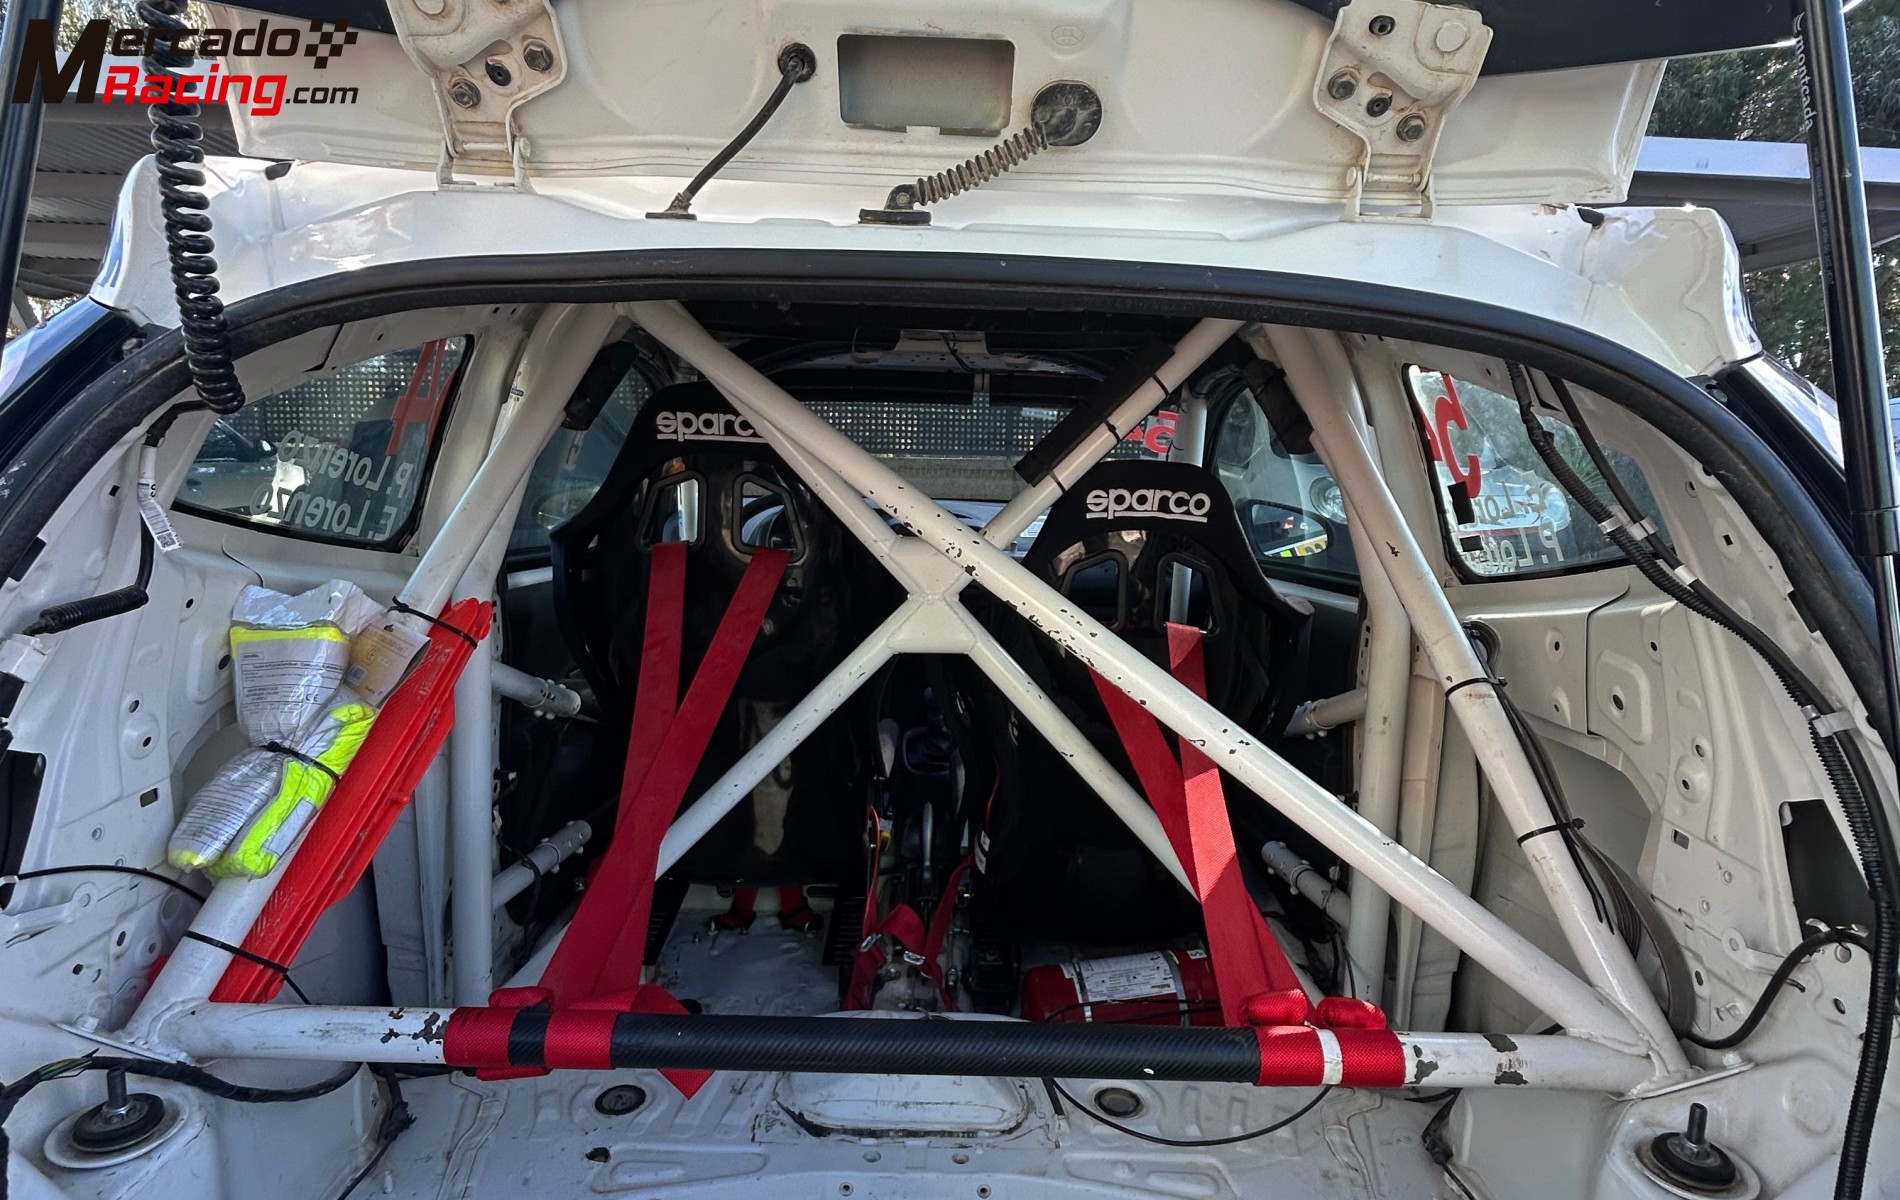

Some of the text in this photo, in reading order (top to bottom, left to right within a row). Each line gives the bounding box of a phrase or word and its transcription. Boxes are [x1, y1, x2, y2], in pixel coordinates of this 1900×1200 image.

[1795, 35, 1817, 132] montcada
[656, 411, 766, 442] sparc
[1086, 488, 1211, 522] sparco
